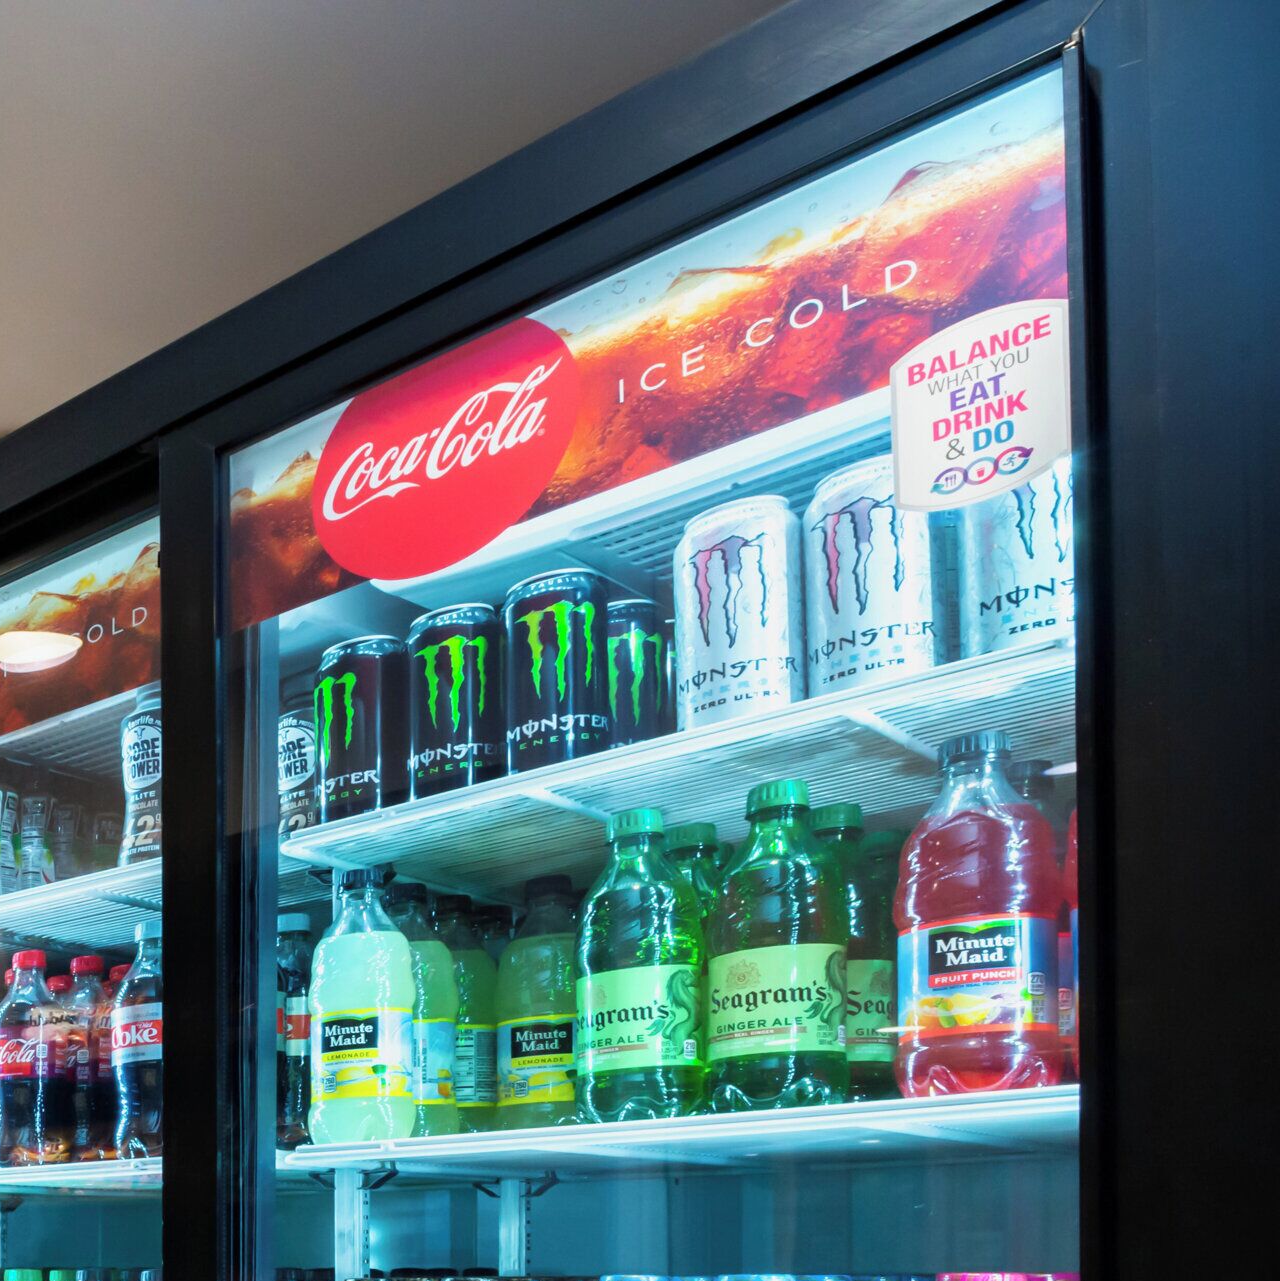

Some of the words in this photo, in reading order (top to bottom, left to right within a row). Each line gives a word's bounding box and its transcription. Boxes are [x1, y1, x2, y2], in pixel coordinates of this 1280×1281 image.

[617, 343, 706, 405] ICE
[745, 259, 920, 349] COLD
[907, 314, 1052, 386] BALANCE
[928, 364, 983, 395] WHAT
[990, 347, 1030, 373] YOU
[933, 390, 1028, 441] DRINK
[322, 356, 562, 521] Coca-Cola
[946, 438, 965, 460] &
[973, 420, 1014, 452] DO
[1009, 616, 1055, 635] ZERO
[679, 655, 797, 695] MONSTR
[822, 666, 856, 684] ZERO
[865, 656, 904, 672] ULTR
[694, 698, 726, 714] ZERO
[506, 712, 608, 743] MONSTER
[519, 732, 601, 751] ENERGY
[407, 741, 500, 772] MONSTE
[418, 759, 484, 778] ENERG
[935, 934, 1016, 954] Minute
[945, 949, 1005, 967] Maid
[934, 973, 969, 985] FRUIT
[971, 969, 1016, 981] PUNCH
[710, 979, 828, 1015] Seagram's
[324, 1022, 374, 1038] Minute
[515, 1028, 568, 1041] Minute
[716, 1018, 768, 1034] GINGER
[772, 1016, 804, 1027] ALE
[329, 1033, 368, 1048] Maid
[521, 1039, 559, 1052] Maid
[616, 1034, 645, 1045] ALE
[326, 1051, 370, 1061] LEMONADE
[518, 1056, 564, 1066] LEMONADE
